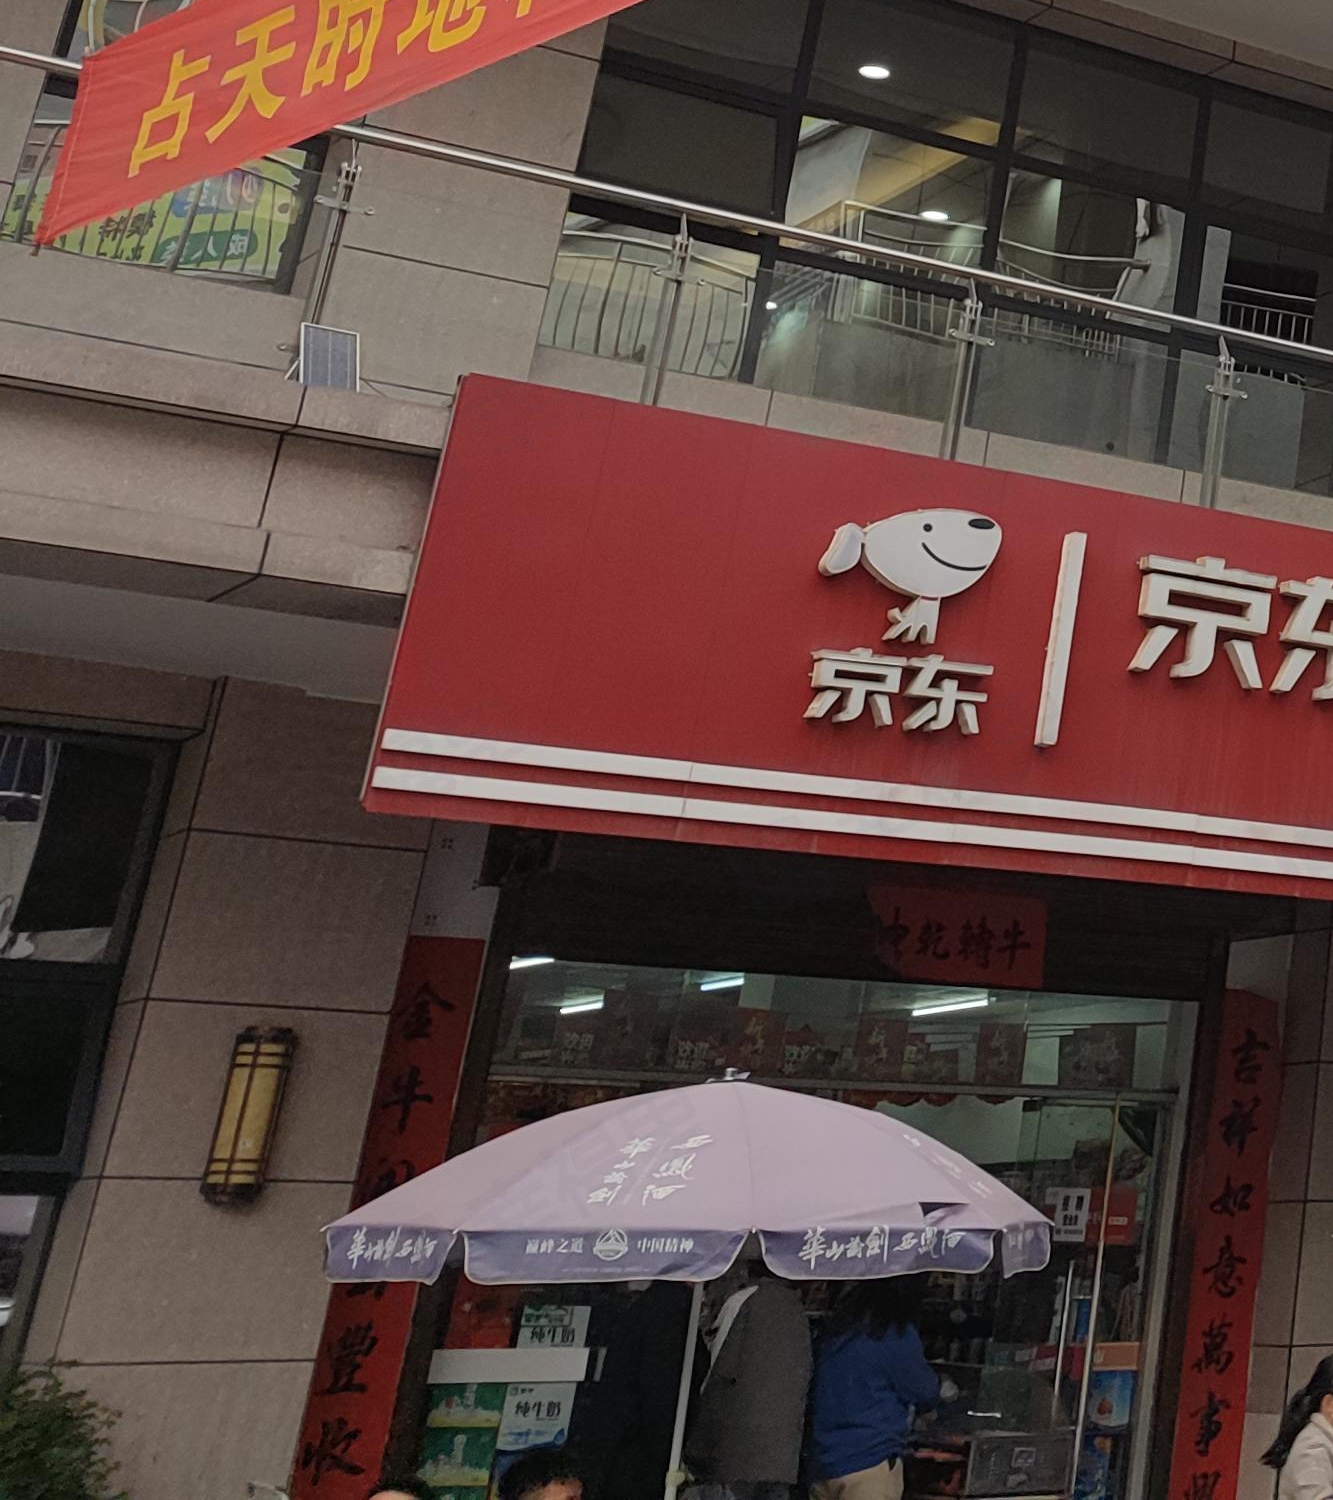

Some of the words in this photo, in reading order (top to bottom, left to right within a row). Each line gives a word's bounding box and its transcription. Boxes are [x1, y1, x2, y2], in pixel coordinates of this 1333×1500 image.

[803, 646, 995, 735] 京东
[529, 1326, 576, 1344] 纯牛奶
[514, 1400, 562, 1419] 纯牛奶
